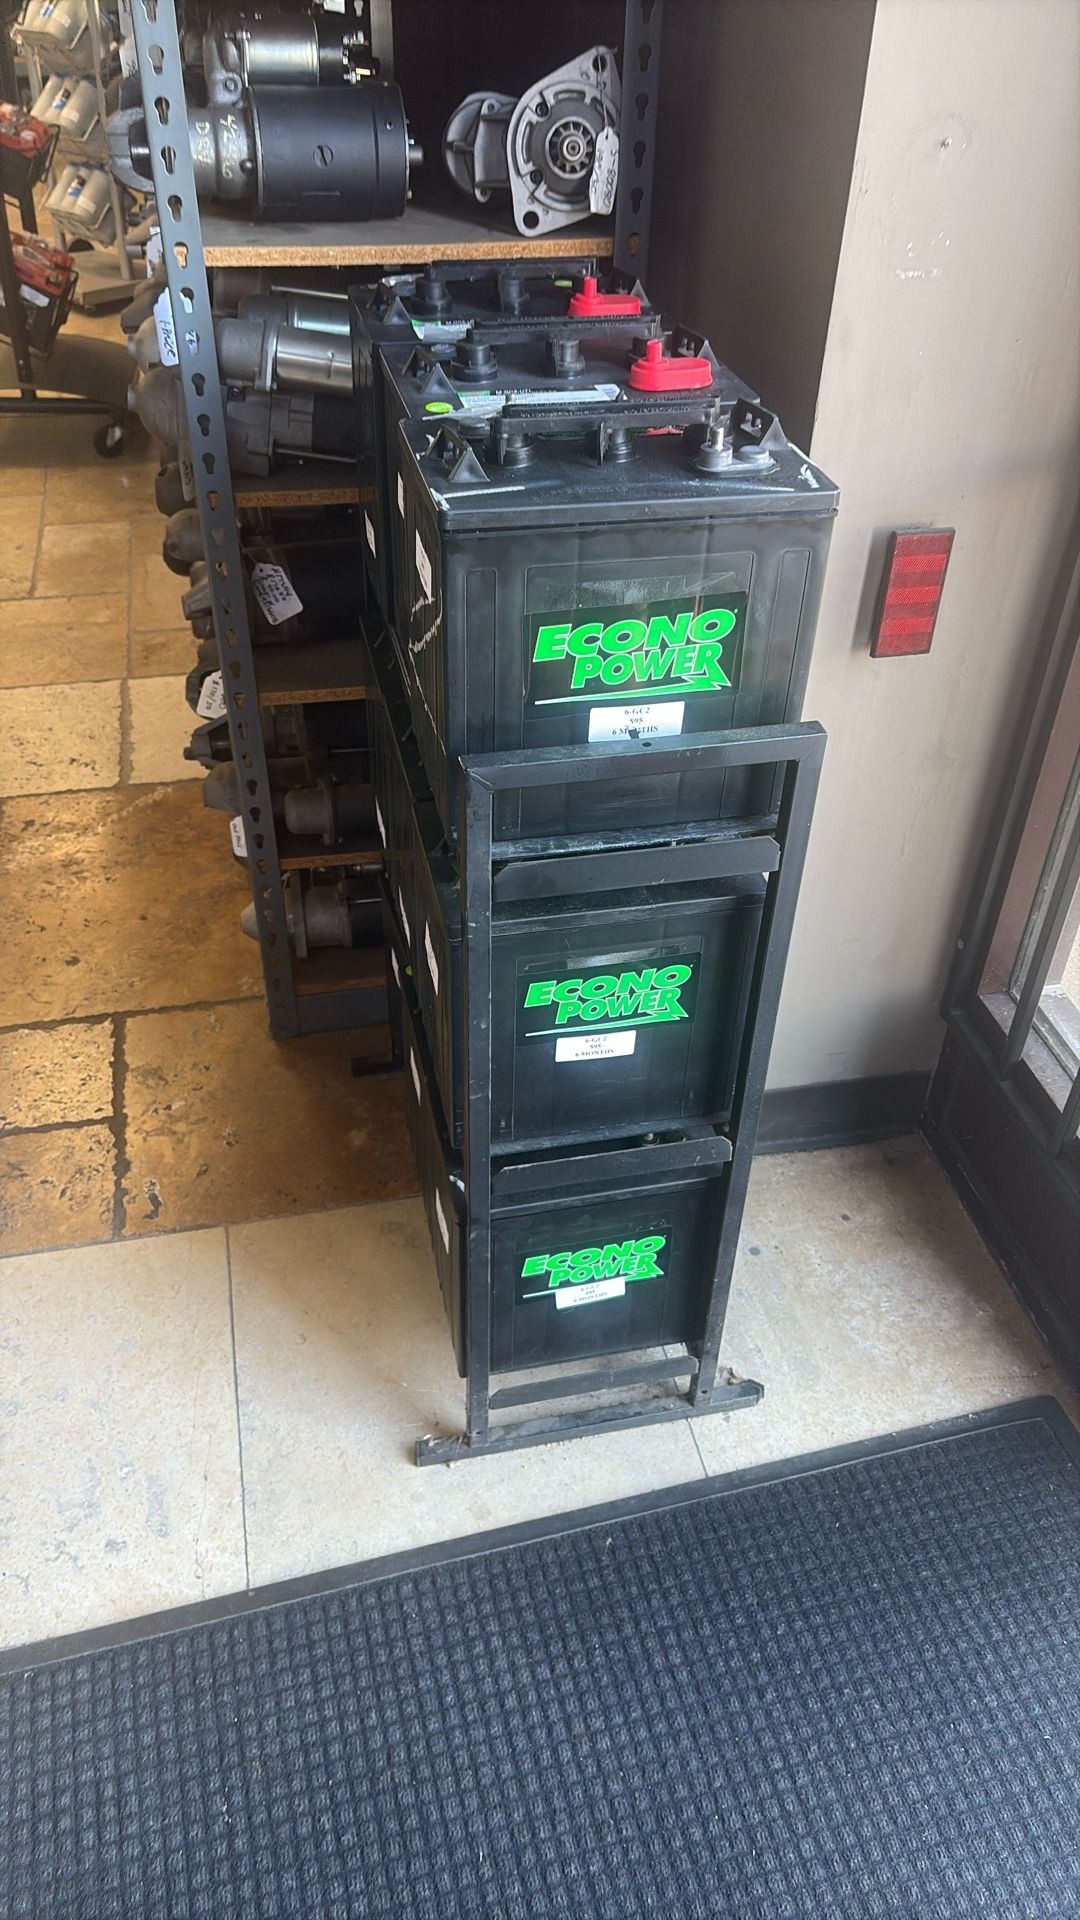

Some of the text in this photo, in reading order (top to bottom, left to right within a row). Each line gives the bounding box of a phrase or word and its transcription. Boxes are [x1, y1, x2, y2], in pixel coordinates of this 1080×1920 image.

[532, 608, 737, 663] ECONO
[571, 641, 732, 689] POWER
[523, 964, 692, 1008] ECONO
[555, 987, 689, 1025] POWER
[521, 1235, 666, 1278] ECONO
[548, 1252, 664, 1288] POWER
